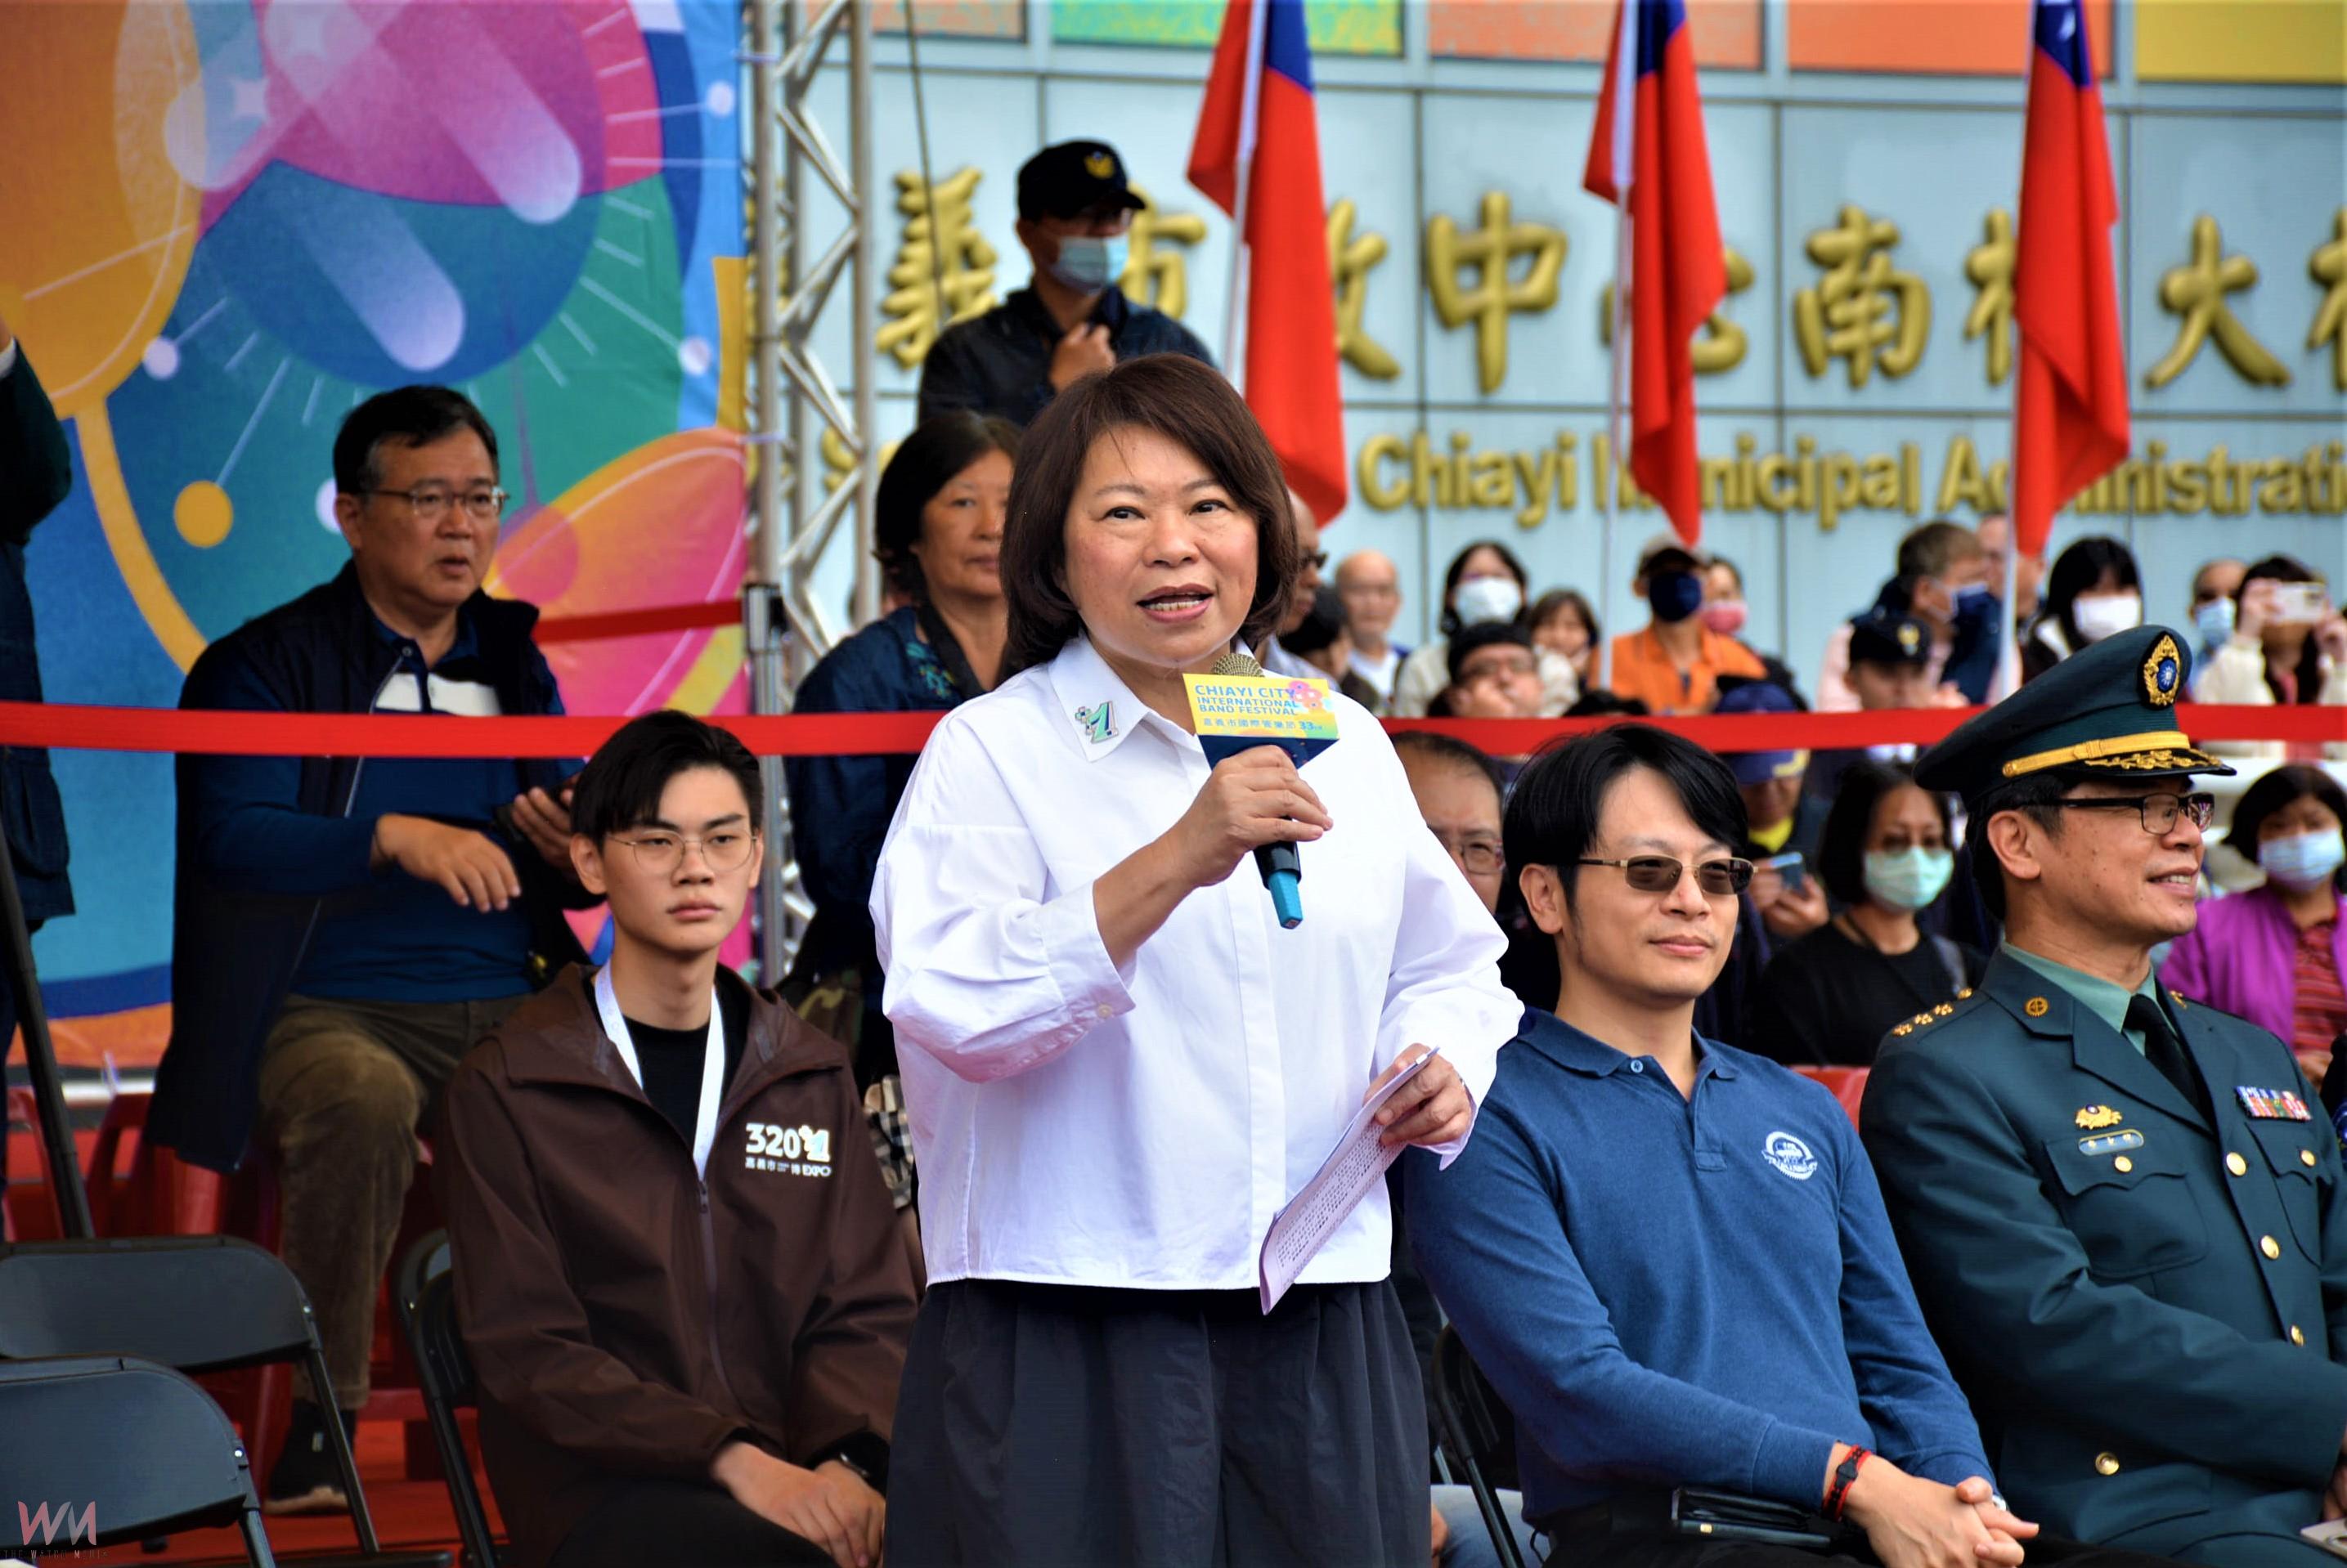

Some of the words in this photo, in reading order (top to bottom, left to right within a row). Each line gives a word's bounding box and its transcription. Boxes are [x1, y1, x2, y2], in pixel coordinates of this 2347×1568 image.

[1356, 430, 1577, 531] Chiayi
[1592, 433, 1919, 532] Mnicipal
[1195, 684, 1253, 697] CHIAYI
[1259, 688, 1297, 699] CITY
[1197, 697, 1299, 708] INTERNATIONAL
[1199, 704, 1235, 714] BAND
[1240, 706, 1299, 716] FESTIVAL
